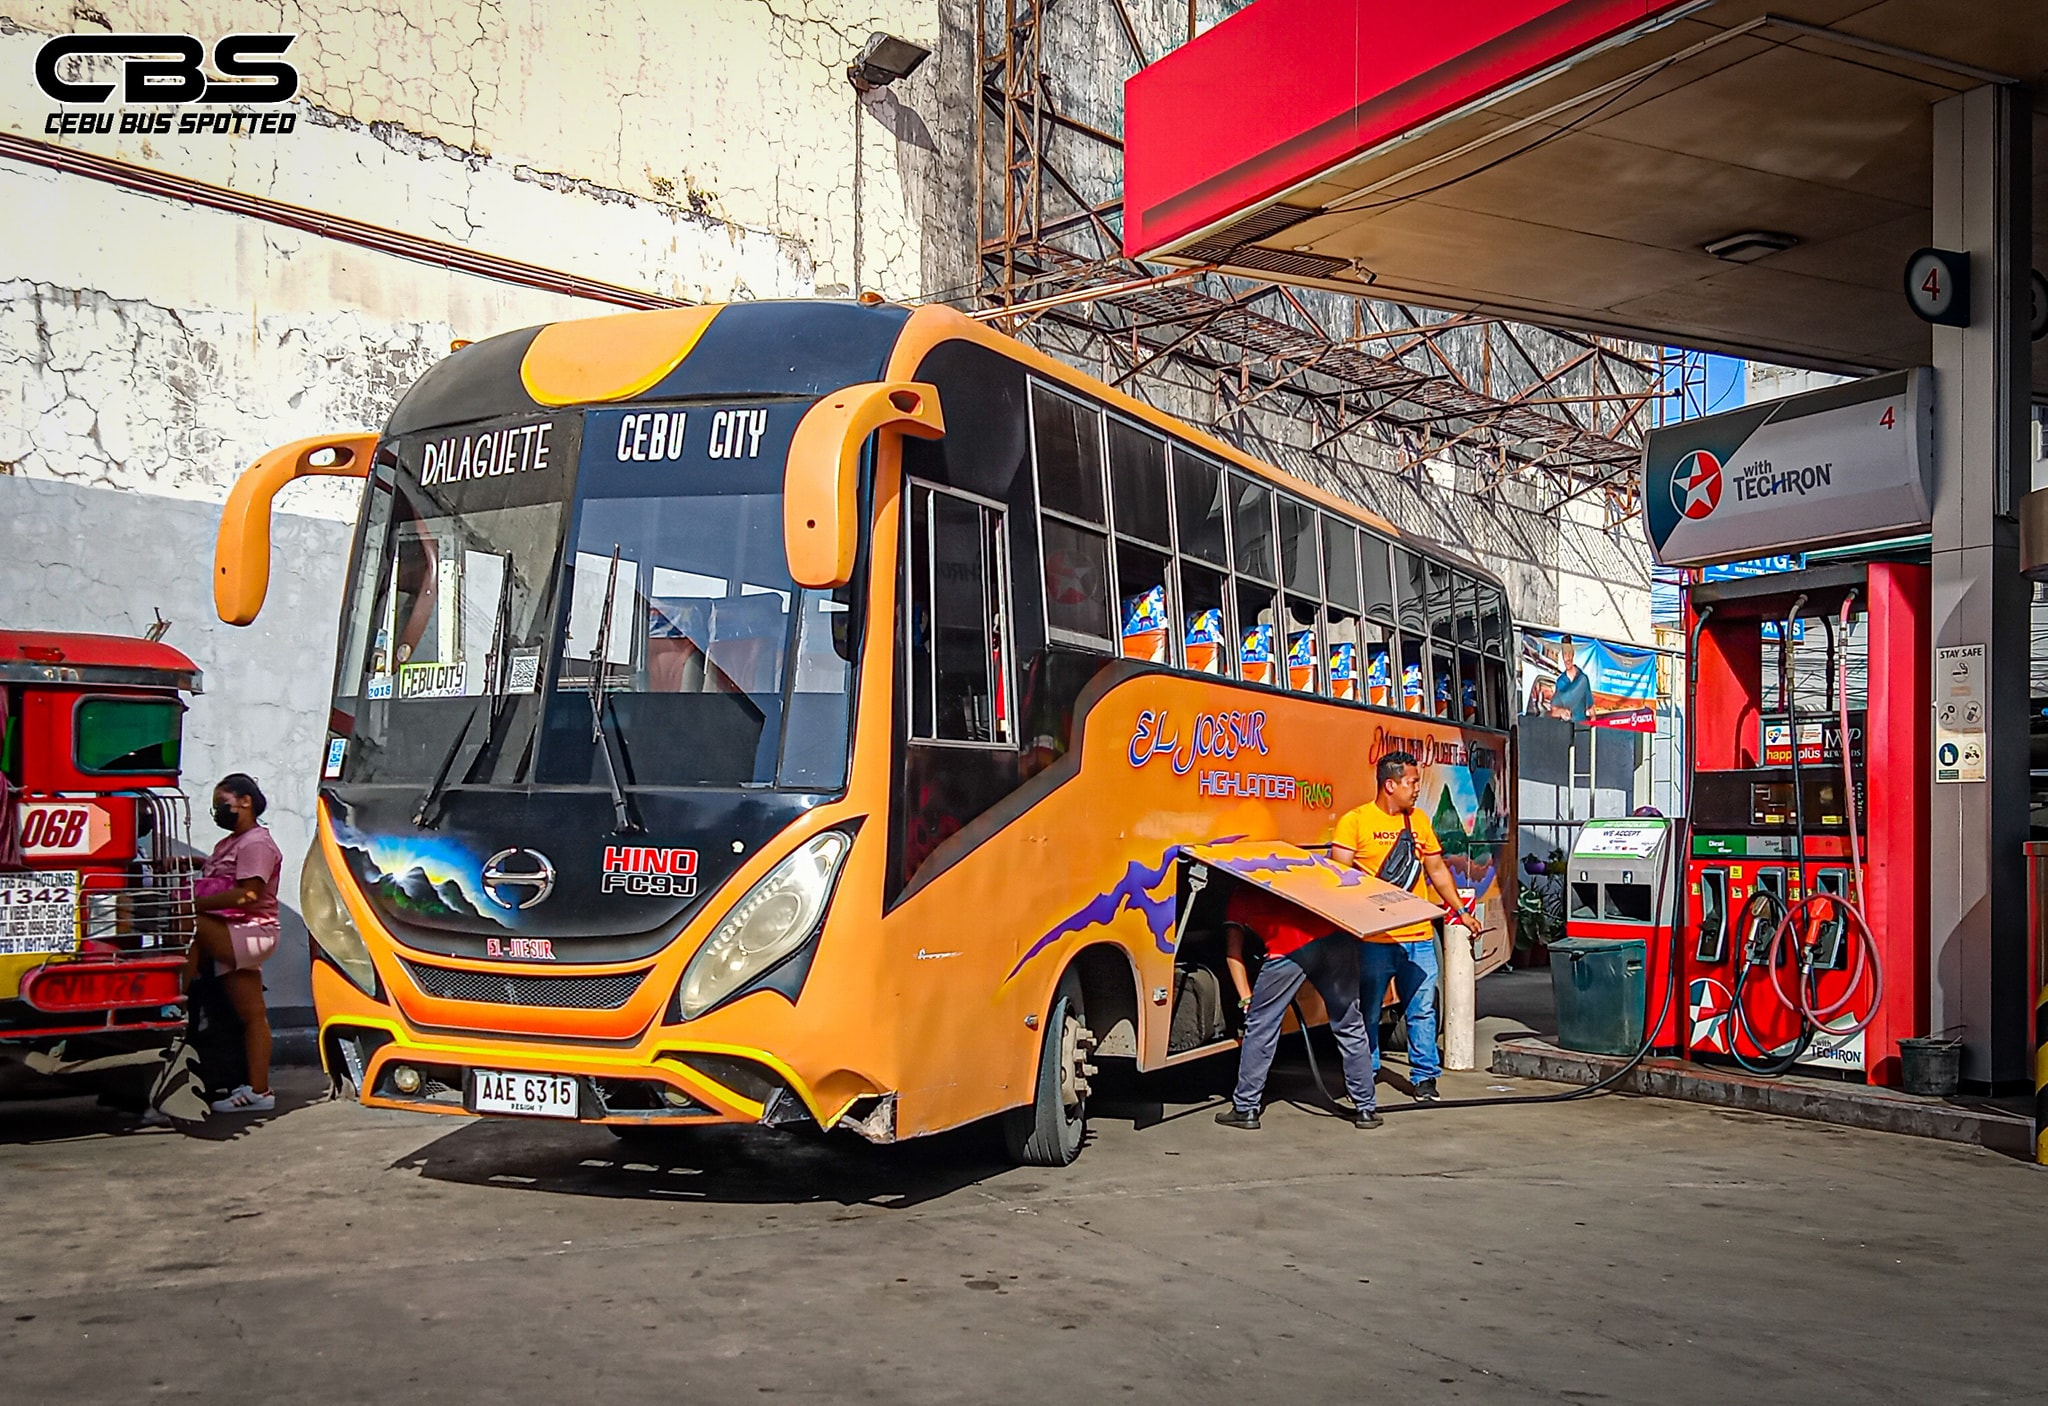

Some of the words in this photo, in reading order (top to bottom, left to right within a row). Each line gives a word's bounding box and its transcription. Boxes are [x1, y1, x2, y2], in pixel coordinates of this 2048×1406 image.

[1921, 268, 1941, 301] 4
[1879, 406, 1895, 430] 4
[616, 412, 688, 463] CEBU
[708, 409, 768, 459] CITY
[420, 422, 553, 487] DALAGUETE
[1743, 460, 1772, 478] with
[1733, 463, 1832, 501] TECHRON
[1939, 650, 1960, 659] STAY
[1961, 647, 1983, 658] SAFE
[368, 685, 392, 698] 2018
[401, 667, 435, 699] CEBU
[436, 664, 465, 689] CITY
[1128, 710, 1178, 767] EL
[20, 809, 89, 848] 06B
[603, 846, 699, 876] HINO
[0, 887, 70, 905] 1342
[601, 873, 697, 898] FC9J
[1810, 1044, 1862, 1064] TECHRON
[482, 1075, 517, 1101] AAE
[524, 1079, 572, 1106] 6315
